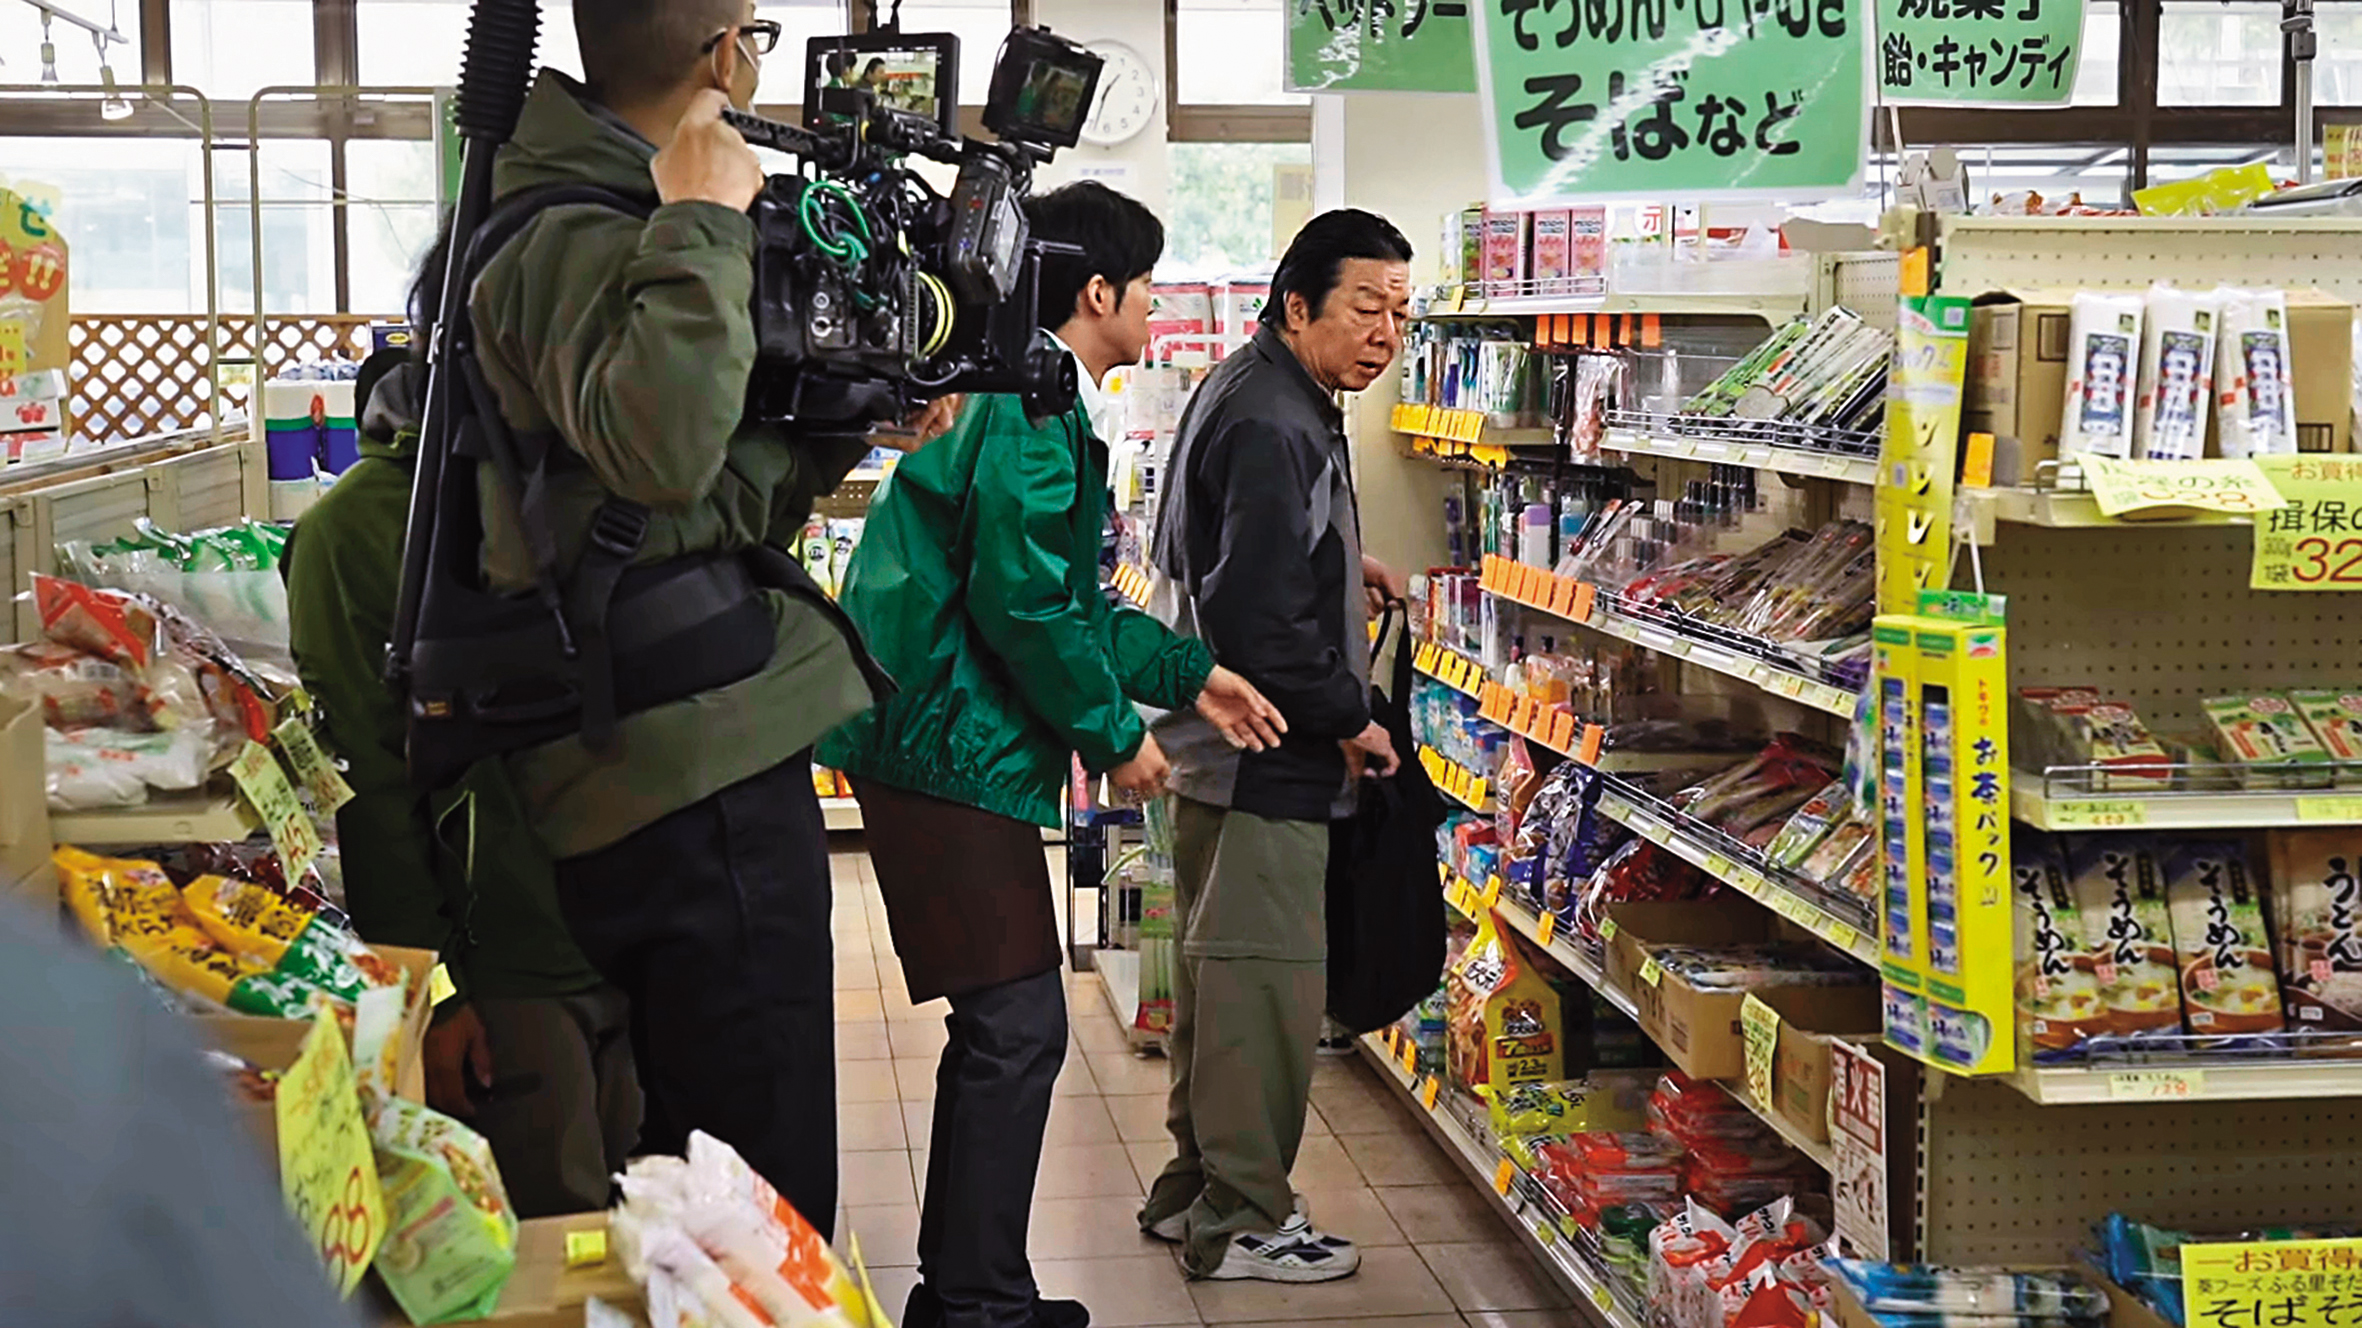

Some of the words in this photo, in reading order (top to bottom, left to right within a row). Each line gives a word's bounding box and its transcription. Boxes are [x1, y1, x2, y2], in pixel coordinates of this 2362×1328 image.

[1883, 32, 2070, 88] 飴・キャンディ
[1514, 70, 1804, 162] そばなど
[1971, 735, 2003, 877] お茶パック
[2016, 868, 2070, 975] そうめん
[2104, 853, 2144, 964] そうめん
[2197, 861, 2244, 969] そうめん
